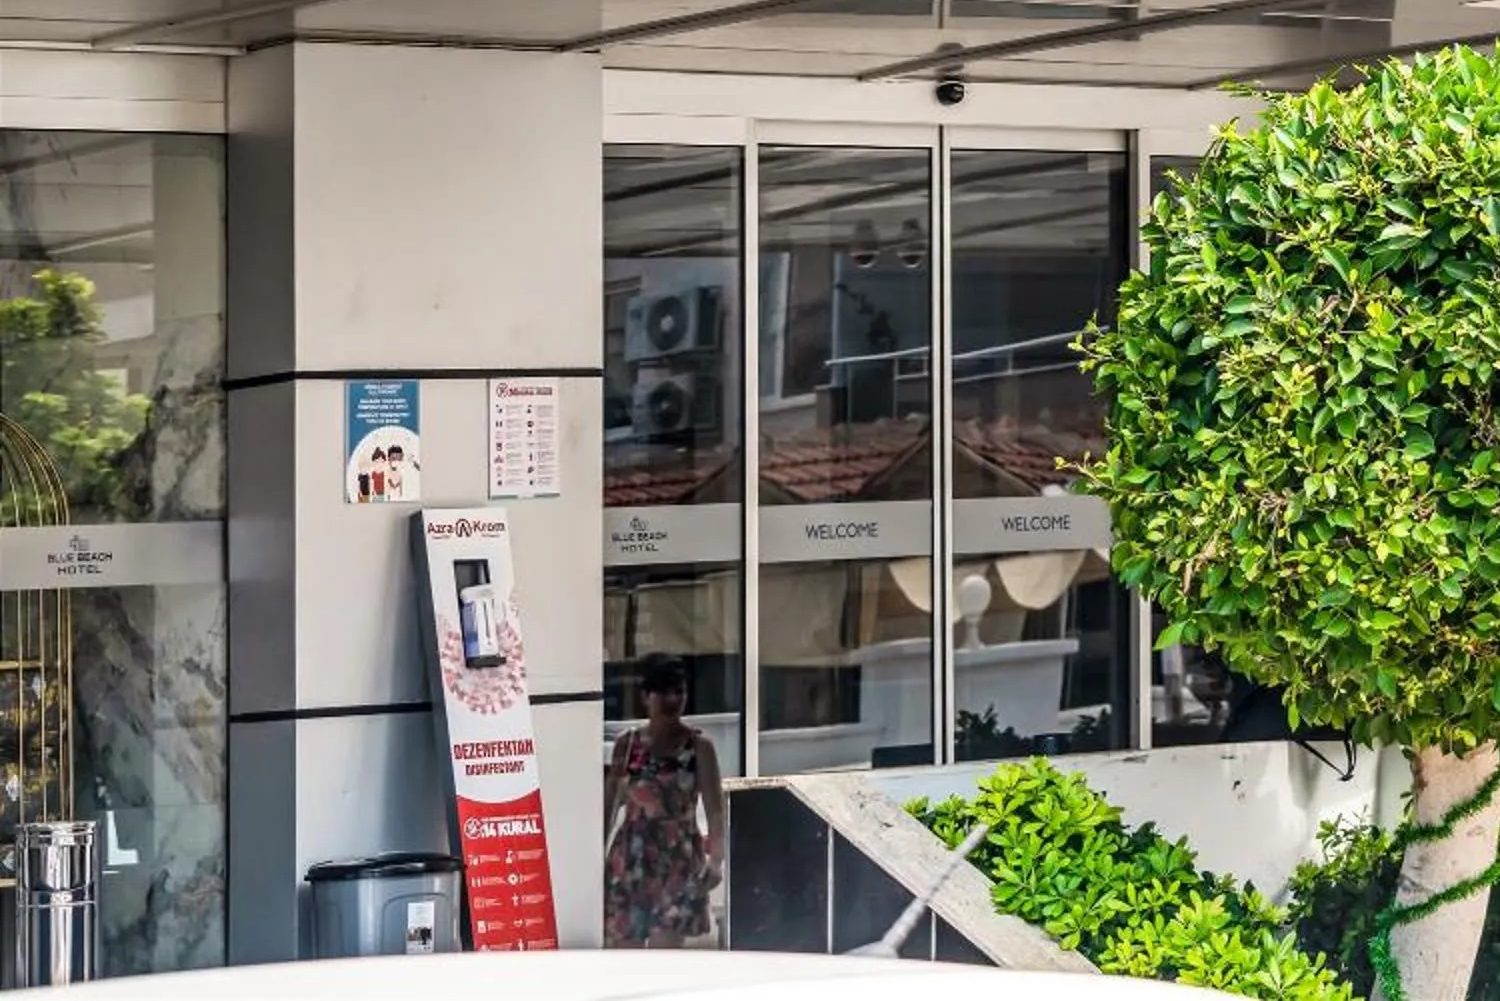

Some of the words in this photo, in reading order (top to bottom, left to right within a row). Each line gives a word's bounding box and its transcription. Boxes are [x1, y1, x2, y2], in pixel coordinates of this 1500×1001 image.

[1002, 515, 1071, 531] WELCOME
[806, 522, 879, 539] WELCOME
[622, 544, 658, 552] HOTEL
[48, 554, 74, 563] BLUE
[77, 552, 113, 562] BEACH
[57, 565, 102, 575] HOTEL
[499, 819, 541, 836] KURAL
